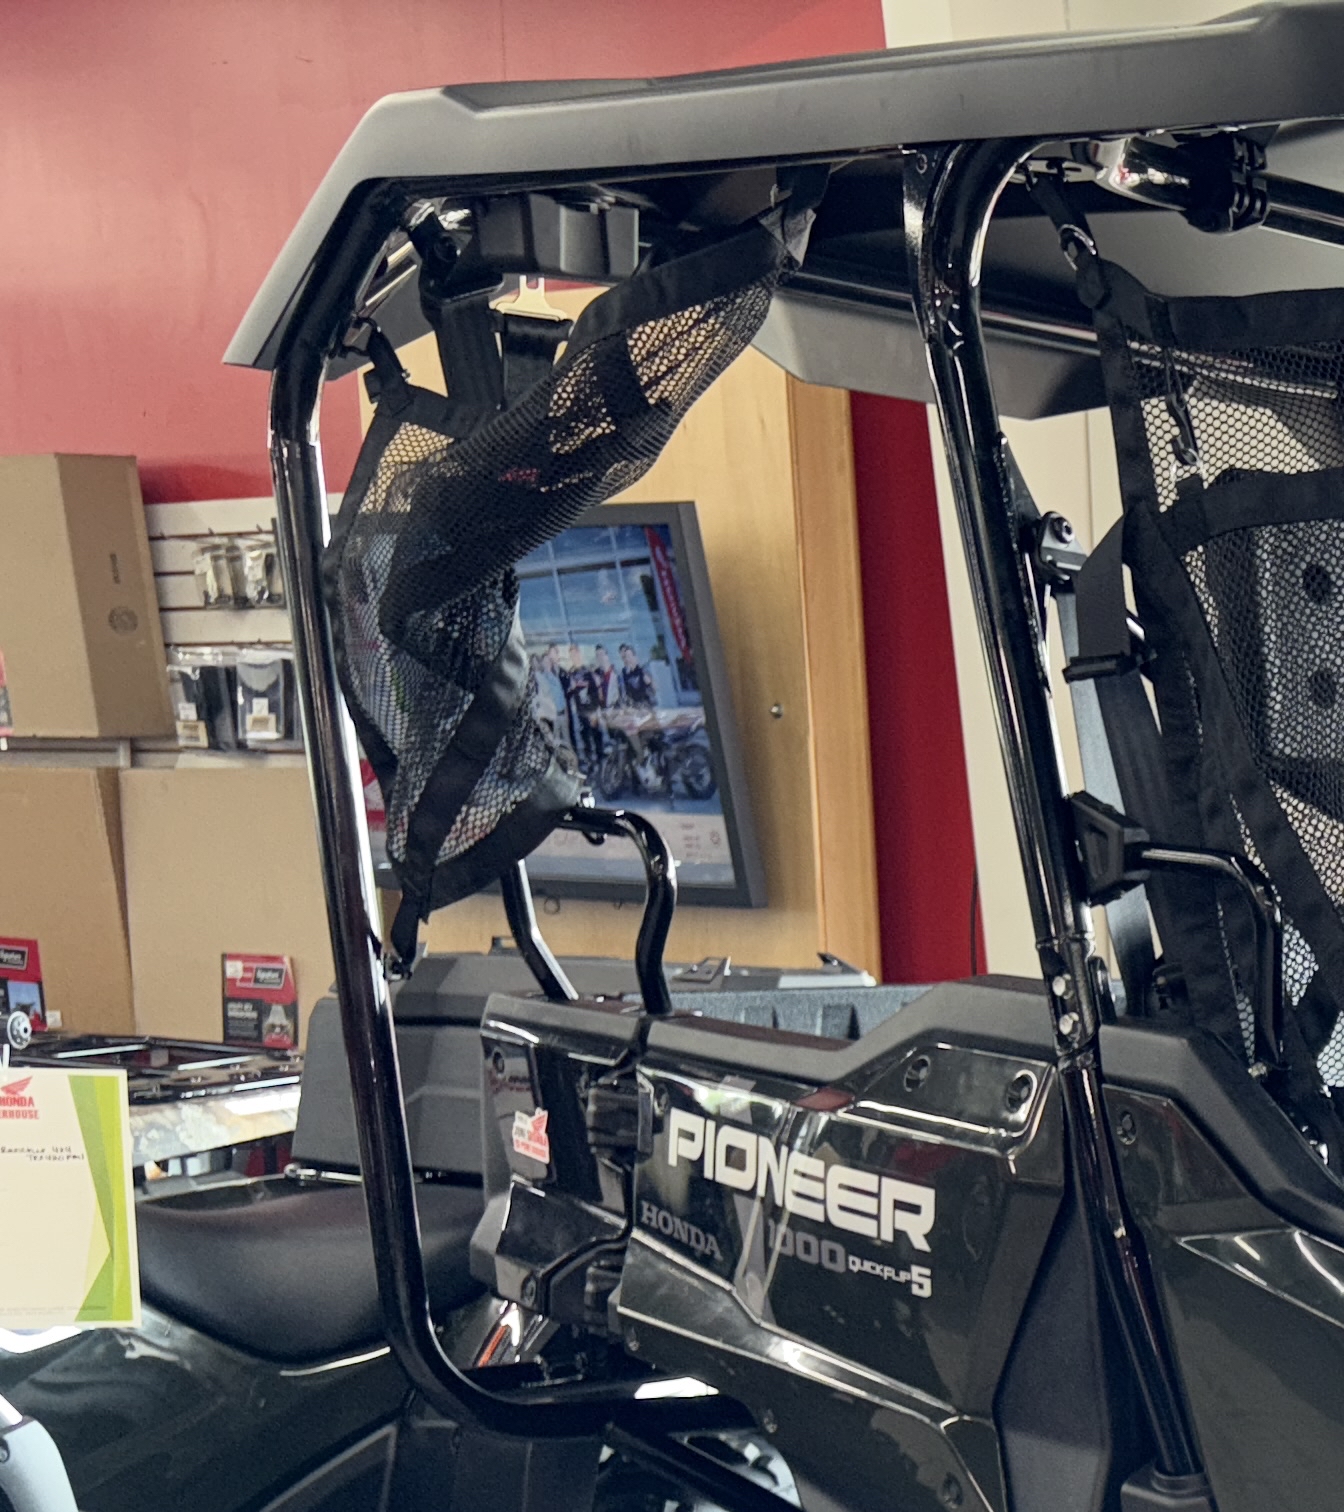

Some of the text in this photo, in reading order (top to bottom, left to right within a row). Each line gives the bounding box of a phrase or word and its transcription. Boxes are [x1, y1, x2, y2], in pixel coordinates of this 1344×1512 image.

[668, 1107, 936, 1252] PIONEER
[640, 1200, 724, 1262] HONDA
[766, 1219, 847, 1274] 1000
